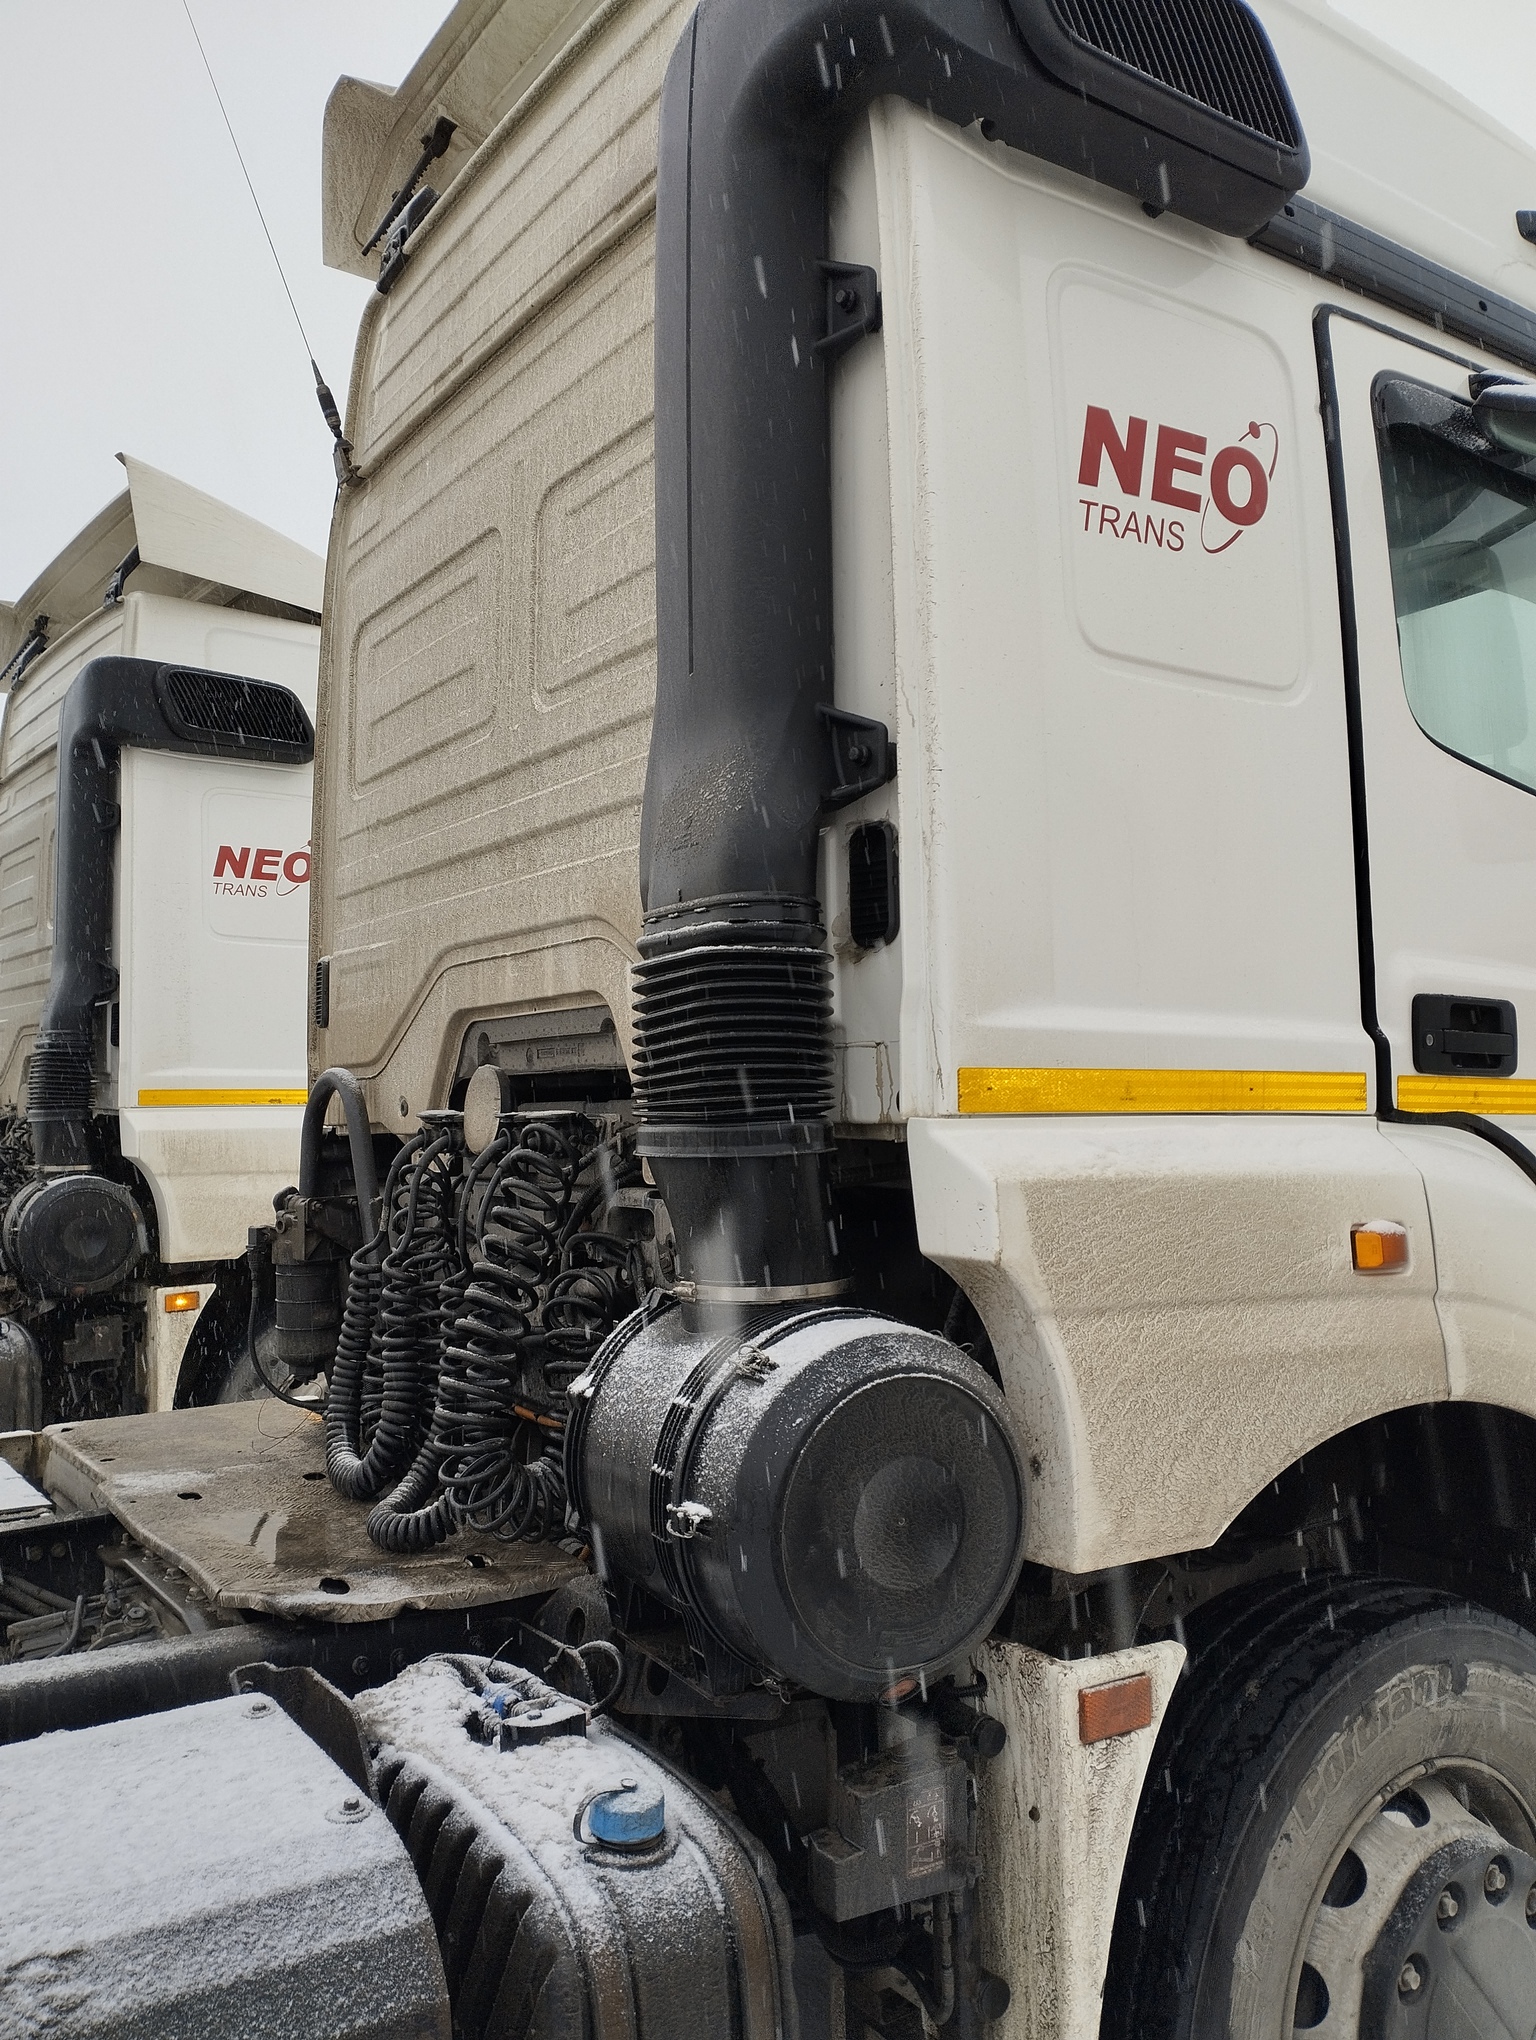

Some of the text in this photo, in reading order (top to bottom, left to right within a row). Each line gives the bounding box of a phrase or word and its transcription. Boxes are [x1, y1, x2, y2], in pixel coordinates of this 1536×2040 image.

[1078, 404, 1269, 526] NEO
[1079, 498, 1185, 552] TRANS
[213, 845, 311, 884] NEO
[213, 882, 268, 898] TRANS
